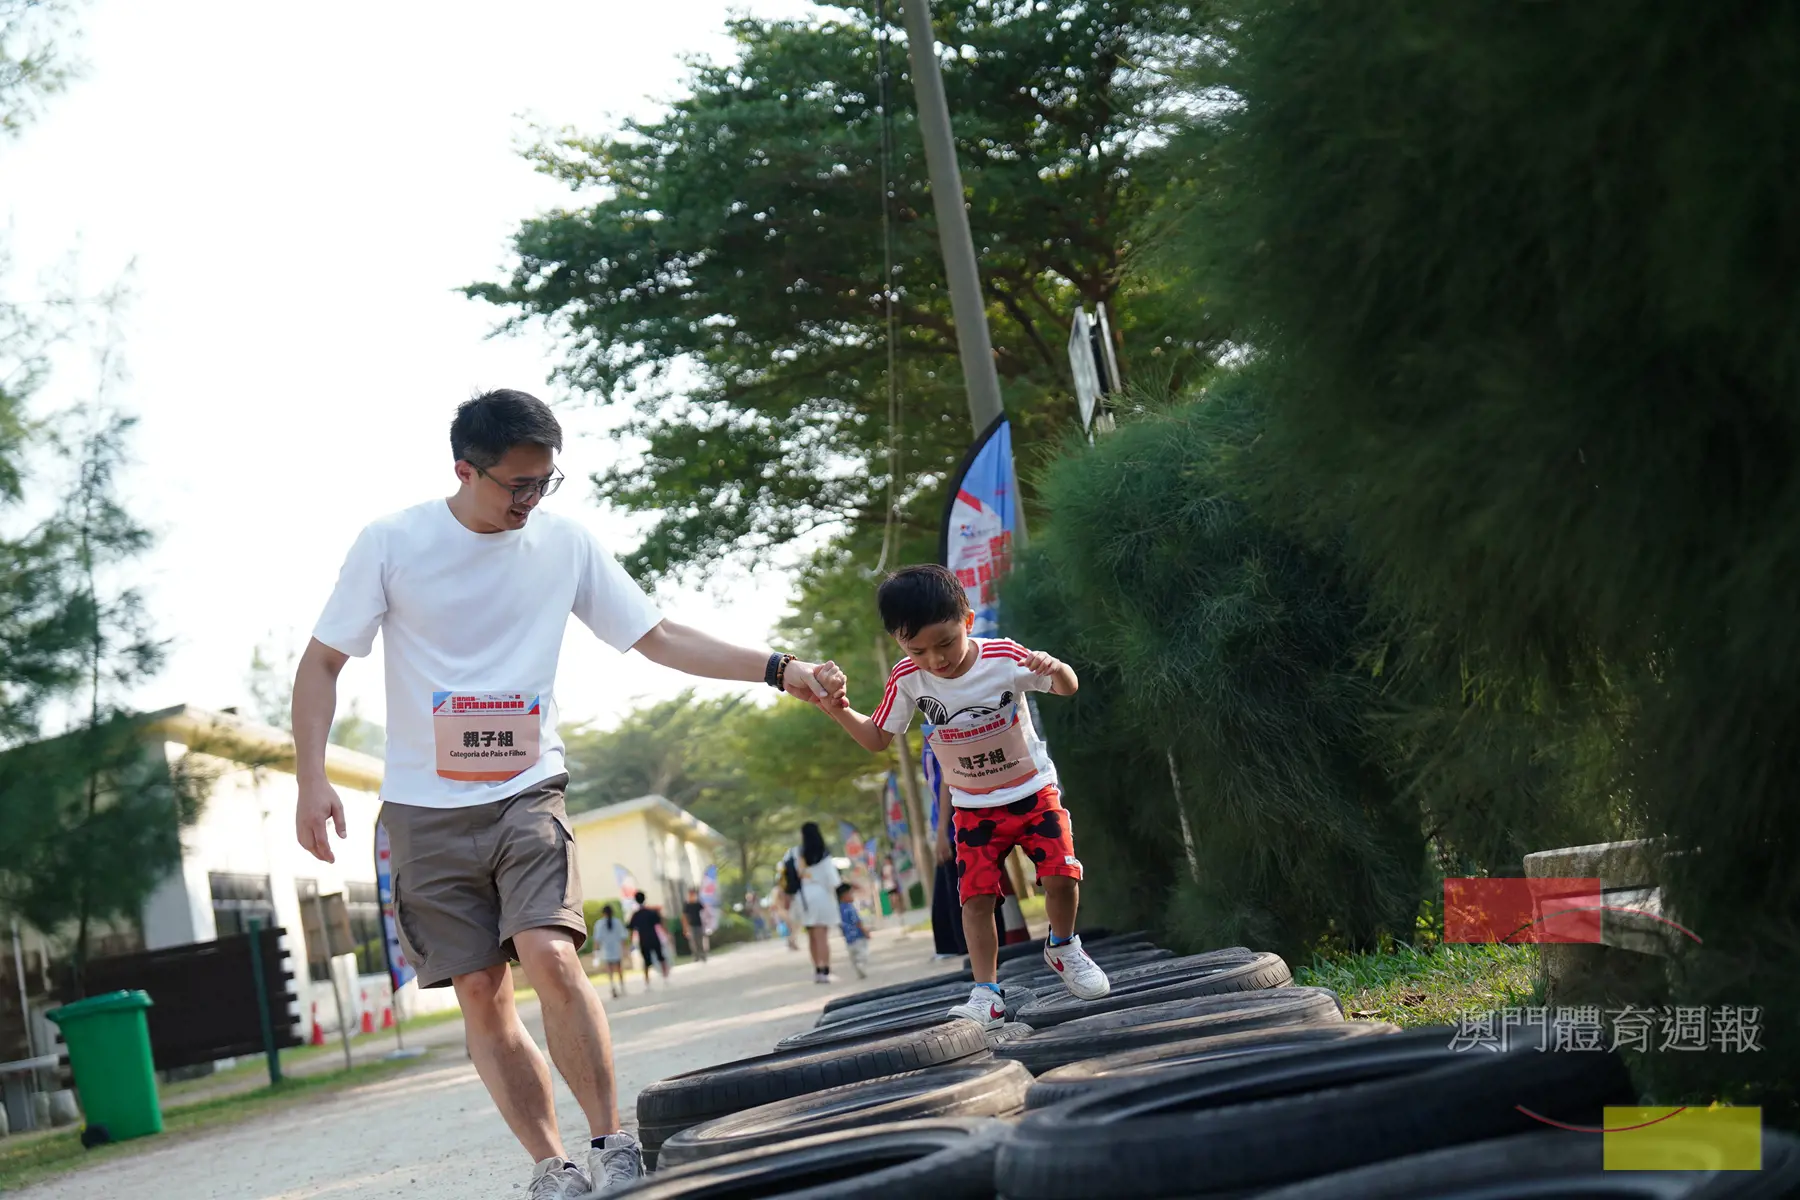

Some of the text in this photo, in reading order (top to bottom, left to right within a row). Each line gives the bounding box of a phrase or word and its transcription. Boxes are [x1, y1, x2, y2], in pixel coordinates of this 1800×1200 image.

[463, 731, 513, 747] 親子組
[450, 750, 480, 759] Categoria
[958, 748, 1006, 769] 親子組
[986, 766, 998, 776] Pais
[1003, 760, 1019, 770] Filhos
